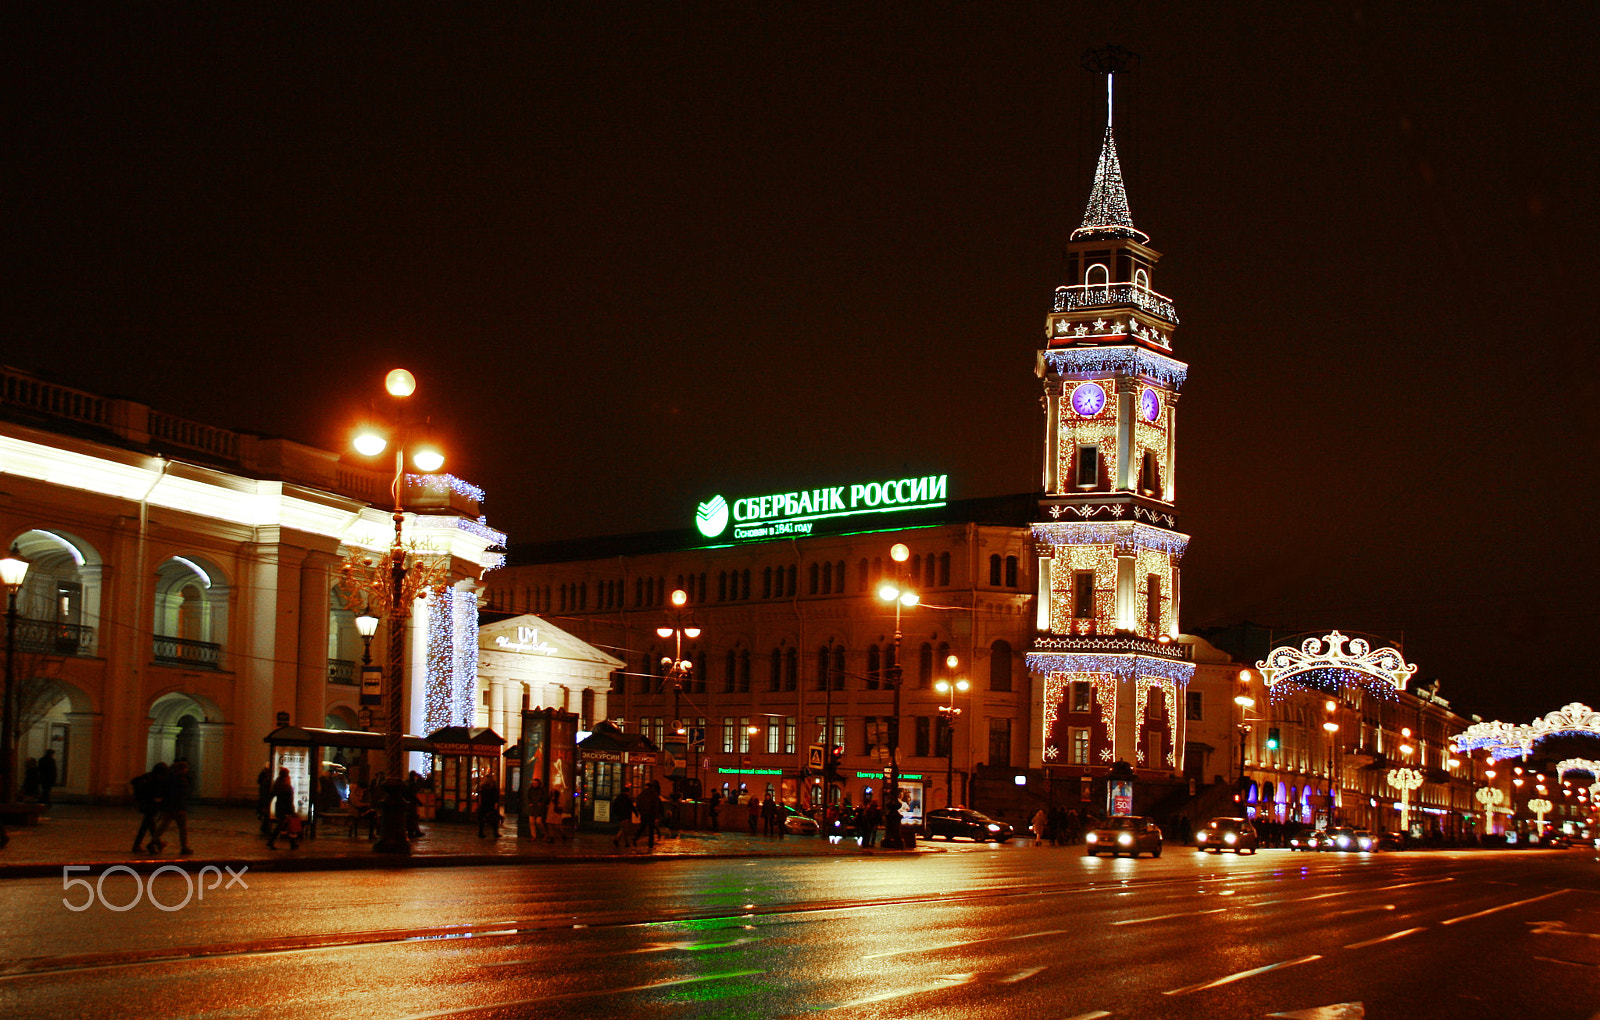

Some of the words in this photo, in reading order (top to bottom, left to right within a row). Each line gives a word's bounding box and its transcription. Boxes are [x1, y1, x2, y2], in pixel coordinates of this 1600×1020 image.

[733, 487, 845, 521] СБЕРБАНК
[851, 475, 947, 507] РОССИИ
[734, 527, 768, 538] Основан
[769, 527, 775, 535] в
[775, 522, 793, 535] 1841
[794, 522, 813, 534] году
[582, 751, 620, 761] ЭКСКУРСИИ
[856, 771, 876, 780] Центр
